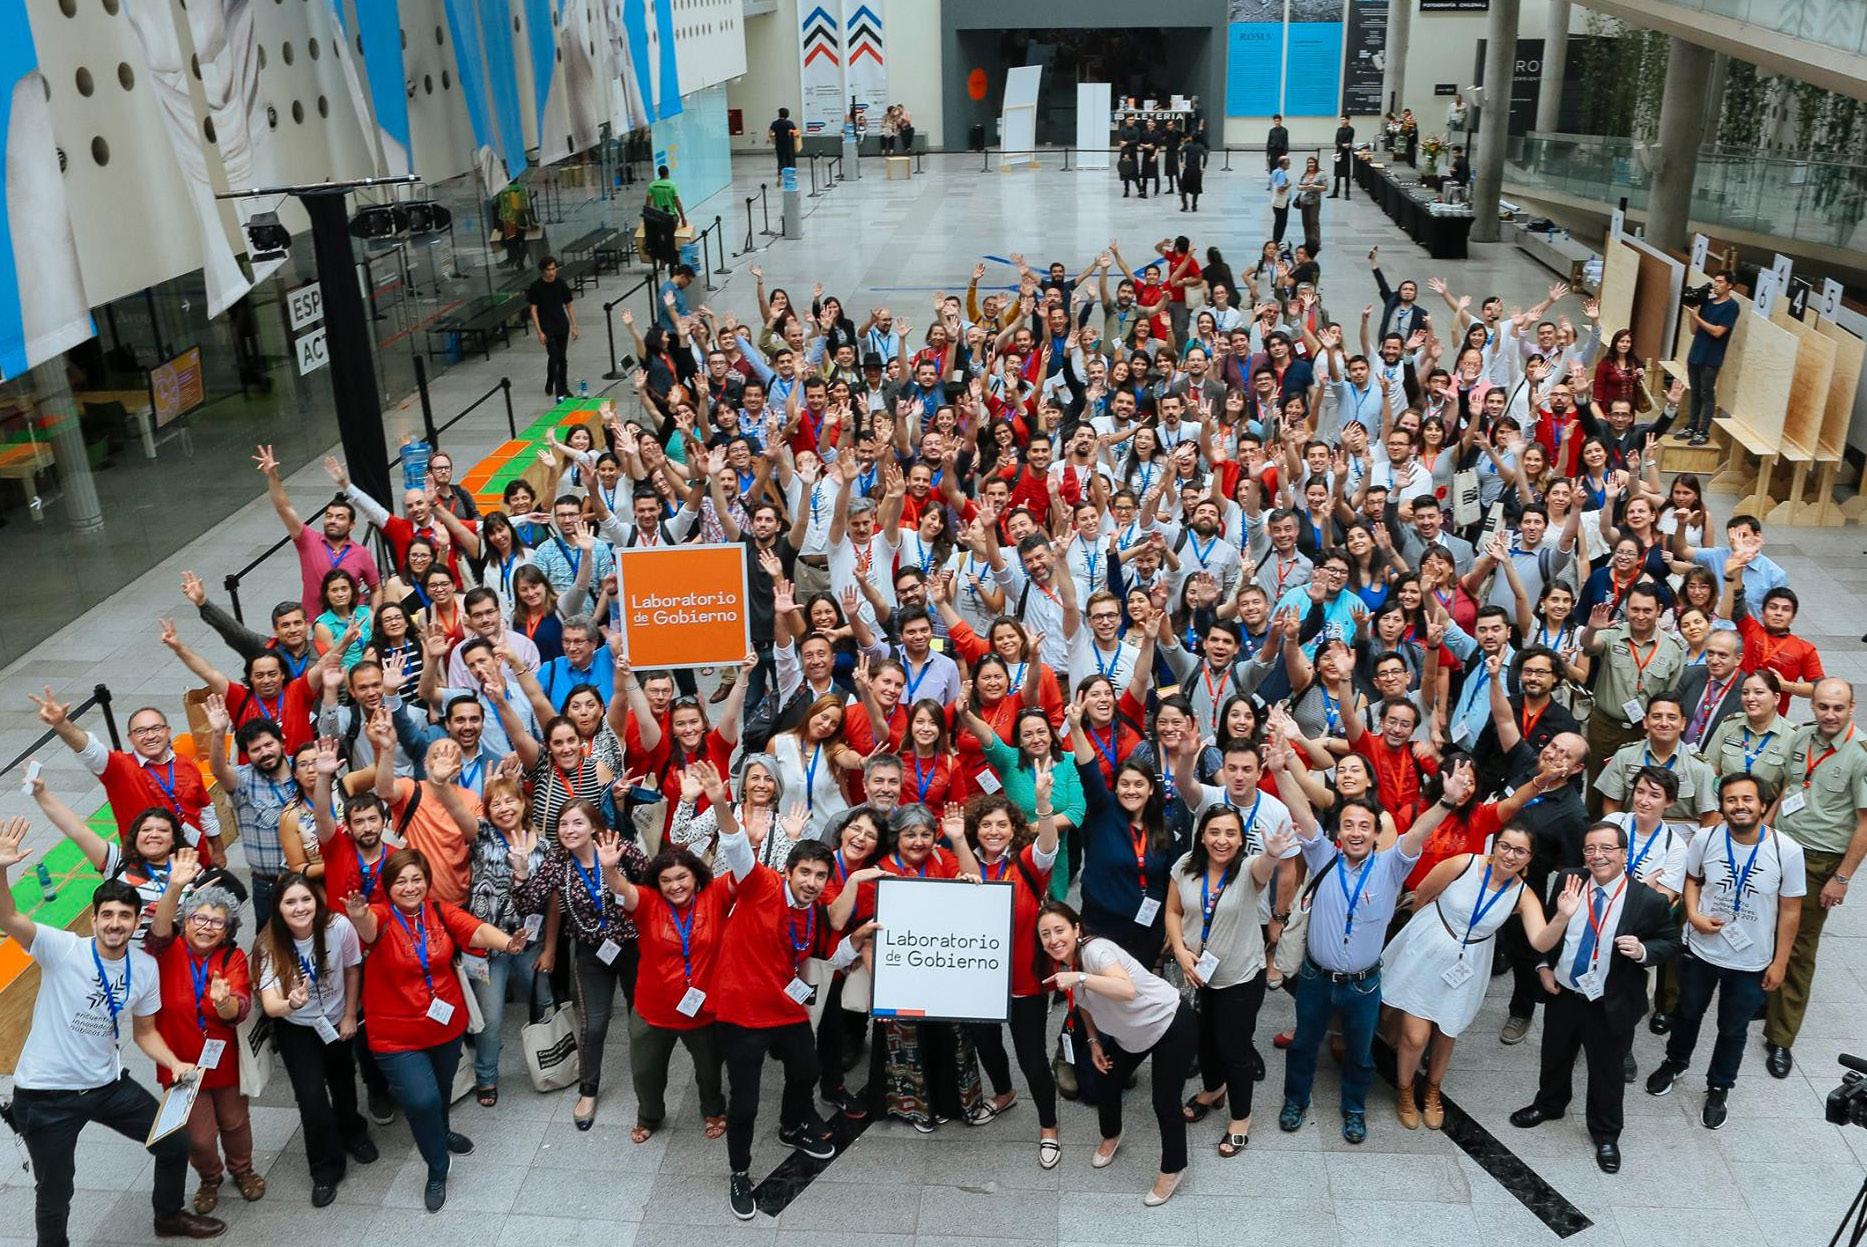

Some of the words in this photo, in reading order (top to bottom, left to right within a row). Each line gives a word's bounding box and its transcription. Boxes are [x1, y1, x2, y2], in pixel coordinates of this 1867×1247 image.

[1115, 112, 1184, 120] BLETERIA
[1758, 285, 1768, 309] 6
[1792, 289, 1805, 315] 4
[1825, 288, 1836, 314] 5
[303, 333, 326, 367] AC
[631, 591, 737, 609] Laboratorio
[633, 611, 649, 625] de
[653, 609, 737, 625] Gobierno
[886, 929, 1000, 950] Laboratorio
[885, 950, 901, 963] de
[907, 950, 999, 969] Gobierno
